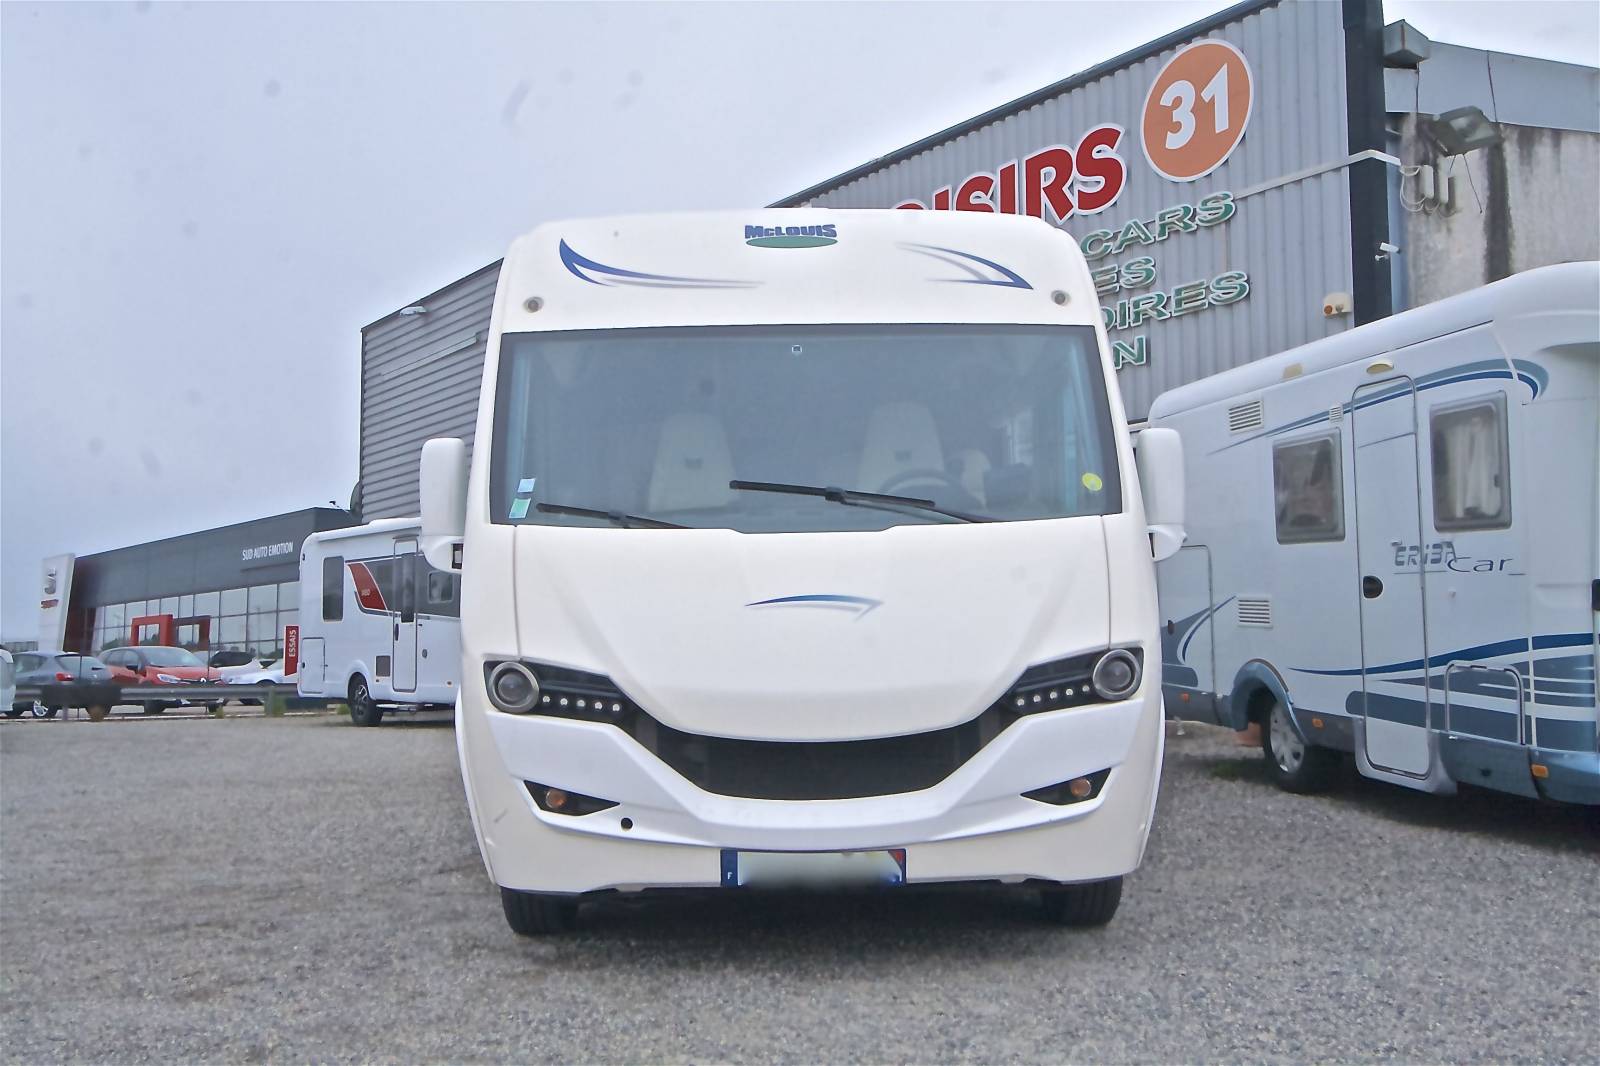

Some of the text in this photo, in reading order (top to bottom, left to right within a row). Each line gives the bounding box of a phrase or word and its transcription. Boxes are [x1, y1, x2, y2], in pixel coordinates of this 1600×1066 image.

[895, 64, 1229, 224] SIRS 31
[1080, 191, 1236, 260] CARS
[242, 541, 294, 561] SUD AUTO EMOTION
[1447, 556, 1513, 573] Car
[288, 629, 297, 657] ESSAIS
[727, 871, 733, 880] F
